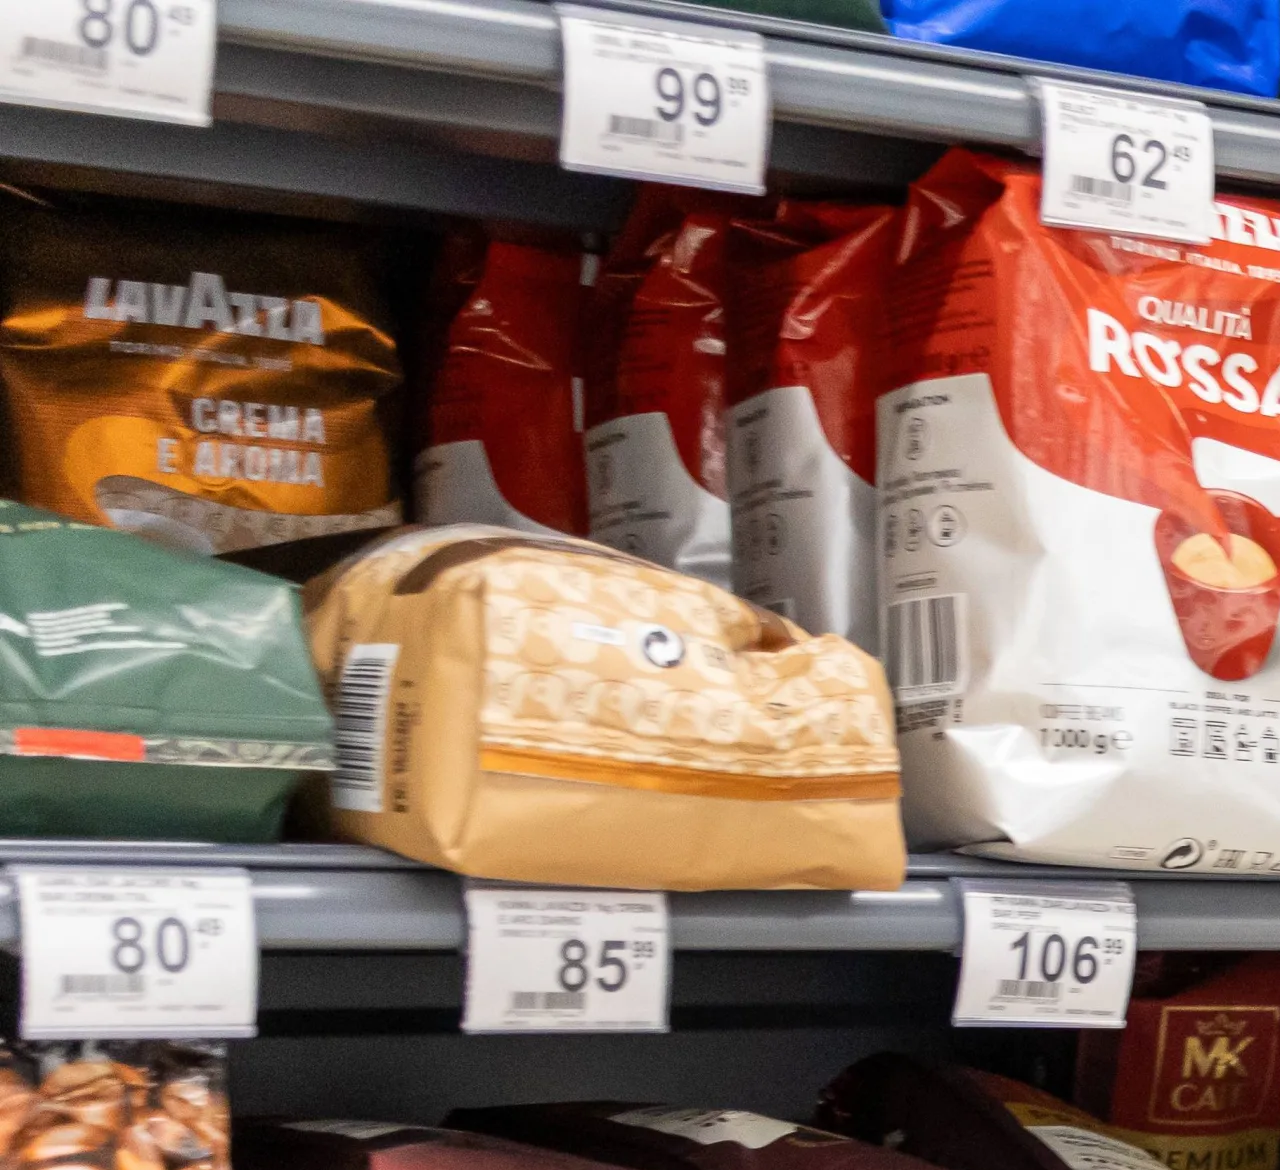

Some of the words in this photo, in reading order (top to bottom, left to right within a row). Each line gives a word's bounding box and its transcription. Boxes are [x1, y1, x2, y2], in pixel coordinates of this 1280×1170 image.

[655, 67, 722, 127] 99
[1111, 133, 1167, 190] 62
[83, 271, 326, 346] LAVAZZA
[1137, 295, 1252, 341] QUALITÀ
[190, 397, 326, 445] CREMA
[156, 438, 179, 474] E
[111, 917, 189, 974] 80
[558, 939, 627, 993] 85
[1011, 931, 1100, 985] 106
[1182, 1035, 1256, 1081] MK
